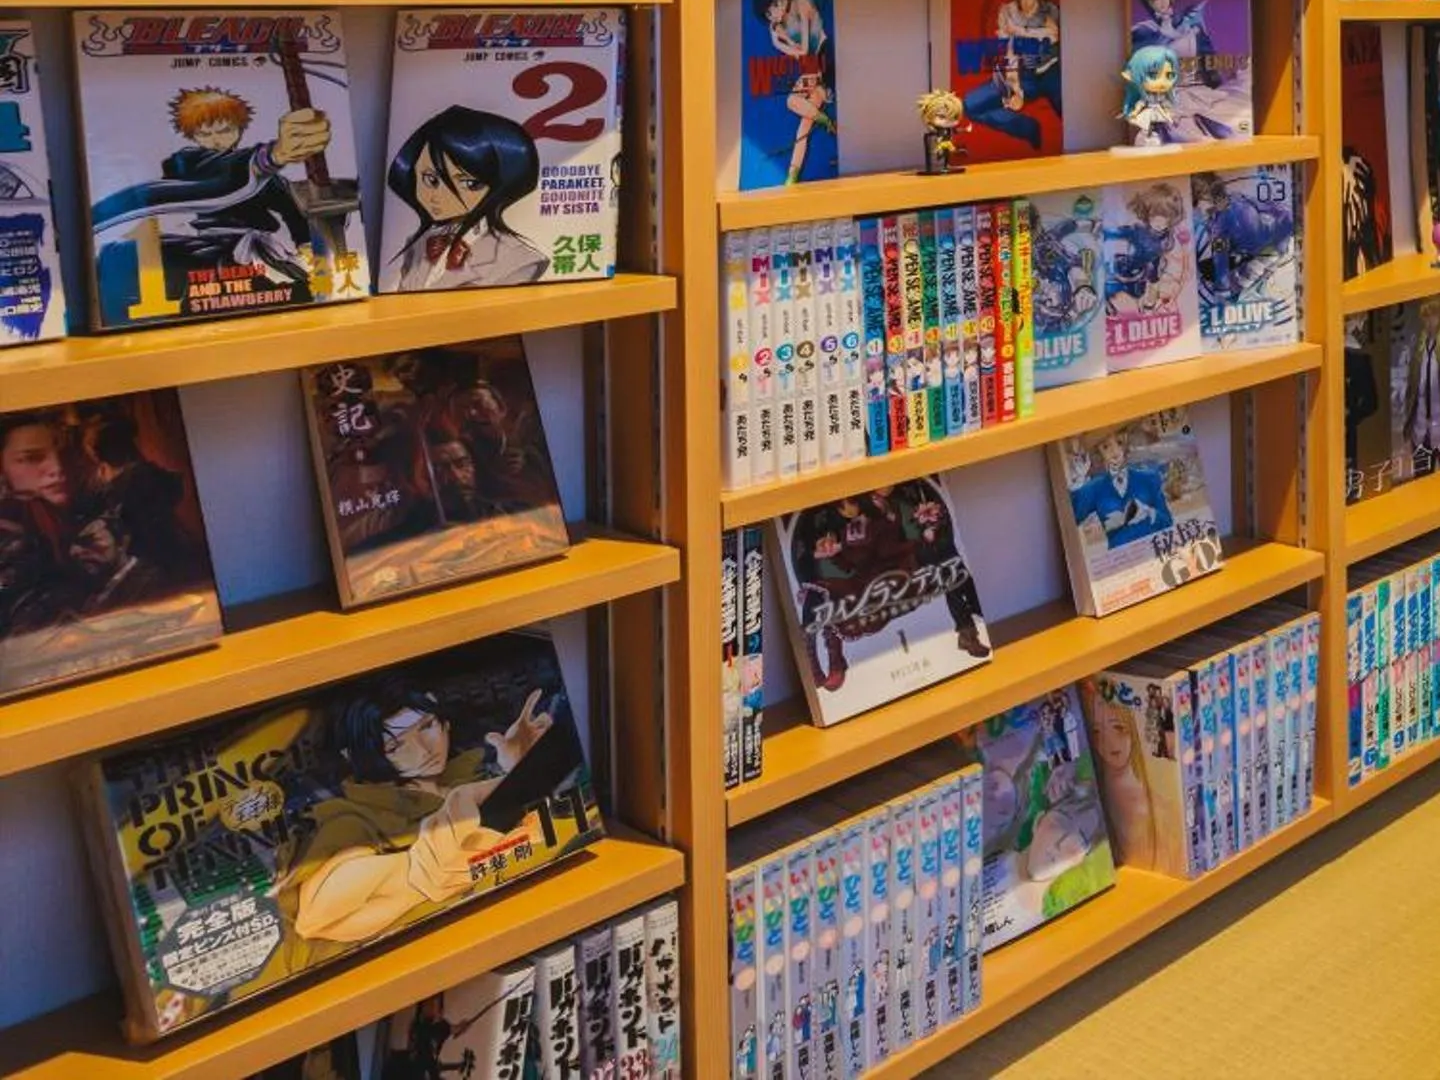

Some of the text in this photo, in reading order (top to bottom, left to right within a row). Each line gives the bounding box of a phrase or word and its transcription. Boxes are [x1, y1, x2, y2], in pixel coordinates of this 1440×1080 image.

[512, 61, 609, 143] 2
[541, 164, 601, 178] GOODBYE
[1256, 181, 1286, 203] 03
[540, 189, 604, 203] GOODNITE
[540, 201, 600, 216] MY SISTA
[123, 216, 182, 320] 1
[553, 233, 603, 255] 久保
[837, 243, 856, 292] MIX
[189, 278, 253, 297] AND THE
[752, 254, 771, 306] MIX
[774, 252, 794, 301] MIX
[793, 250, 812, 300] MIX
[815, 246, 835, 295] MIX
[189, 287, 293, 313] STRAWBERRY
[329, 364, 374, 437] 史記
[176, 897, 258, 944] 完全版
